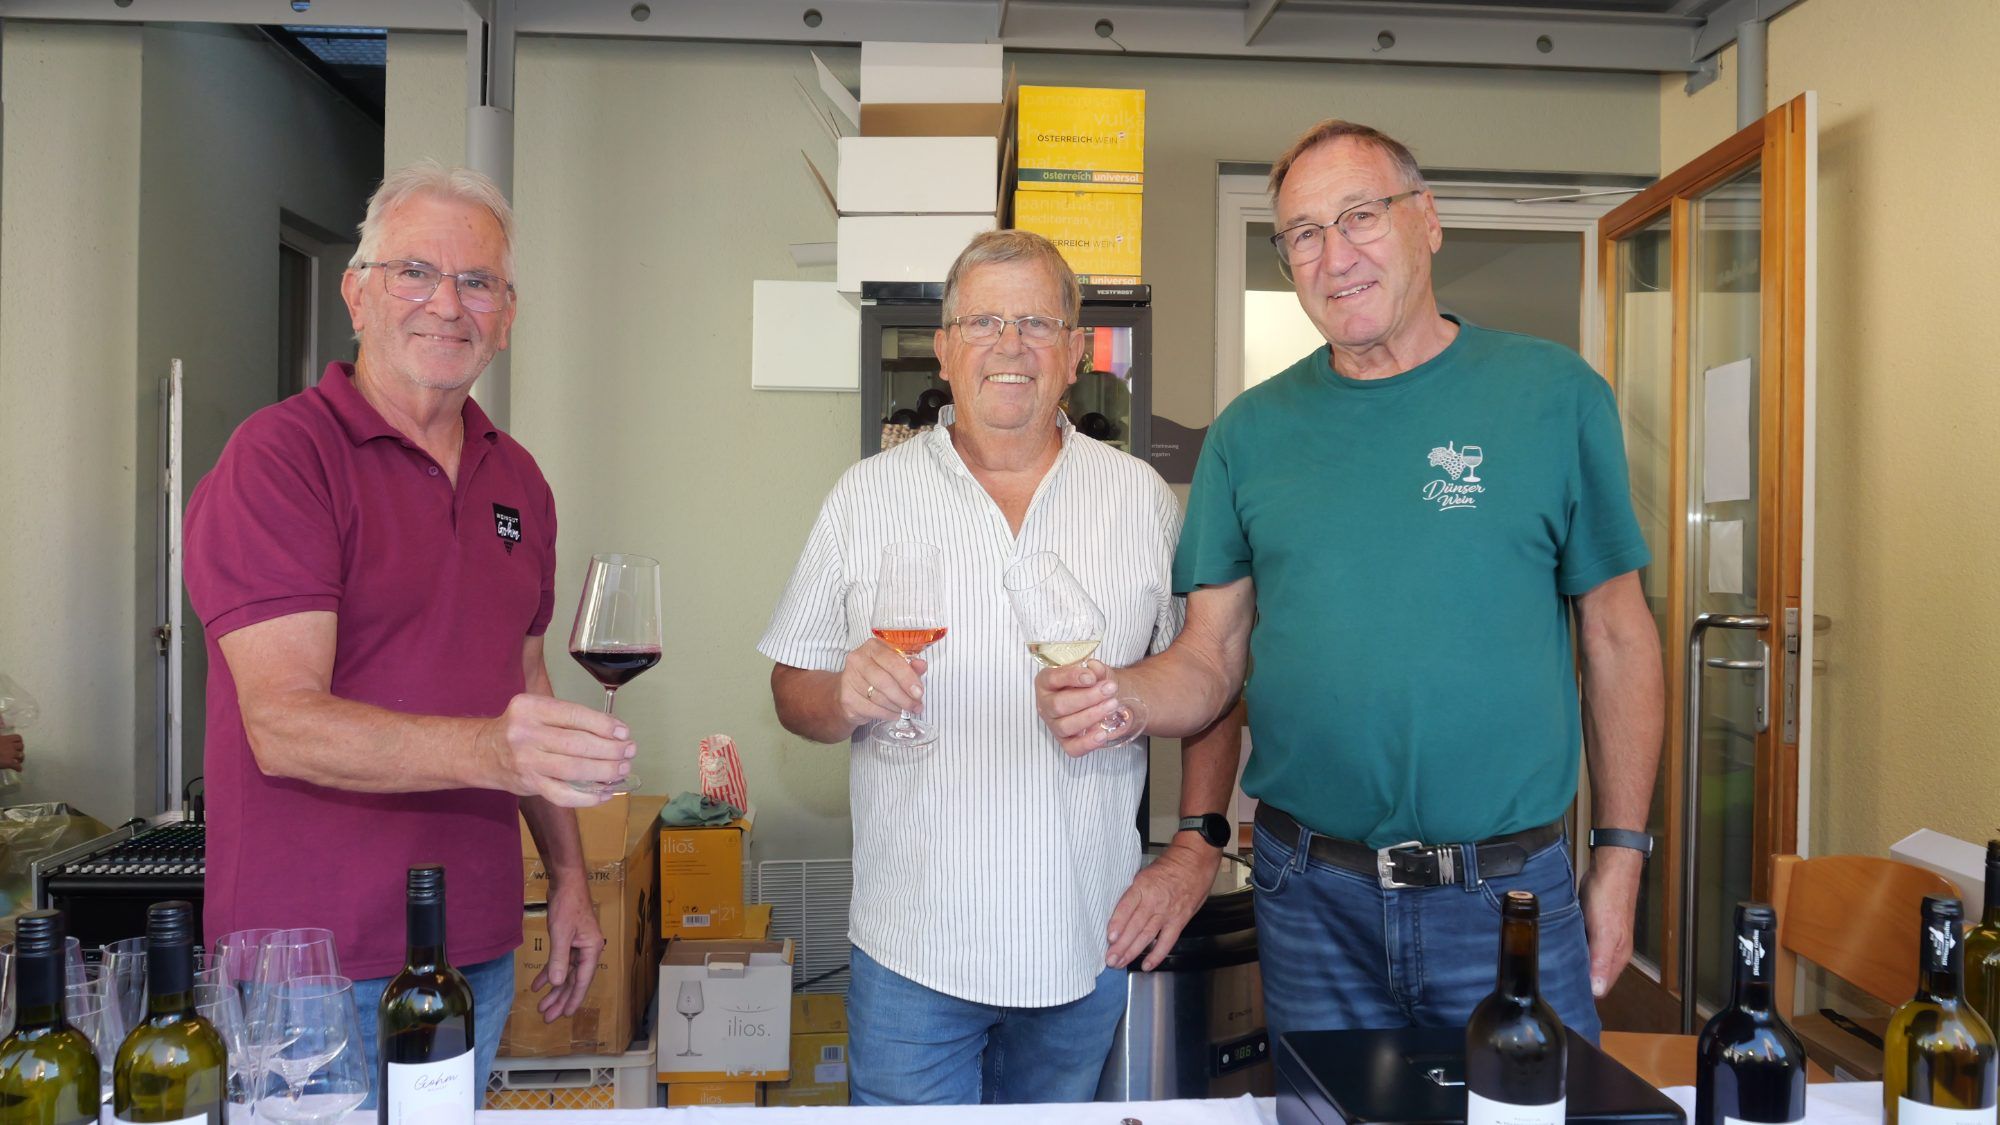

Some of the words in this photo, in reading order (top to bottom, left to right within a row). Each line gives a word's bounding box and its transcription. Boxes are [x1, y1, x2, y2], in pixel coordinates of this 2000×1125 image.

[1037, 133, 1092, 144] ÖSTERREICH
[1094, 136, 1118, 145] WEIN
[1042, 170, 1092, 181] österreich
[1094, 172, 1139, 183] universal
[1093, 240, 1116, 249] WEIN
[1423, 479, 1485, 500] Dünser
[1437, 494, 1475, 506] Wein
